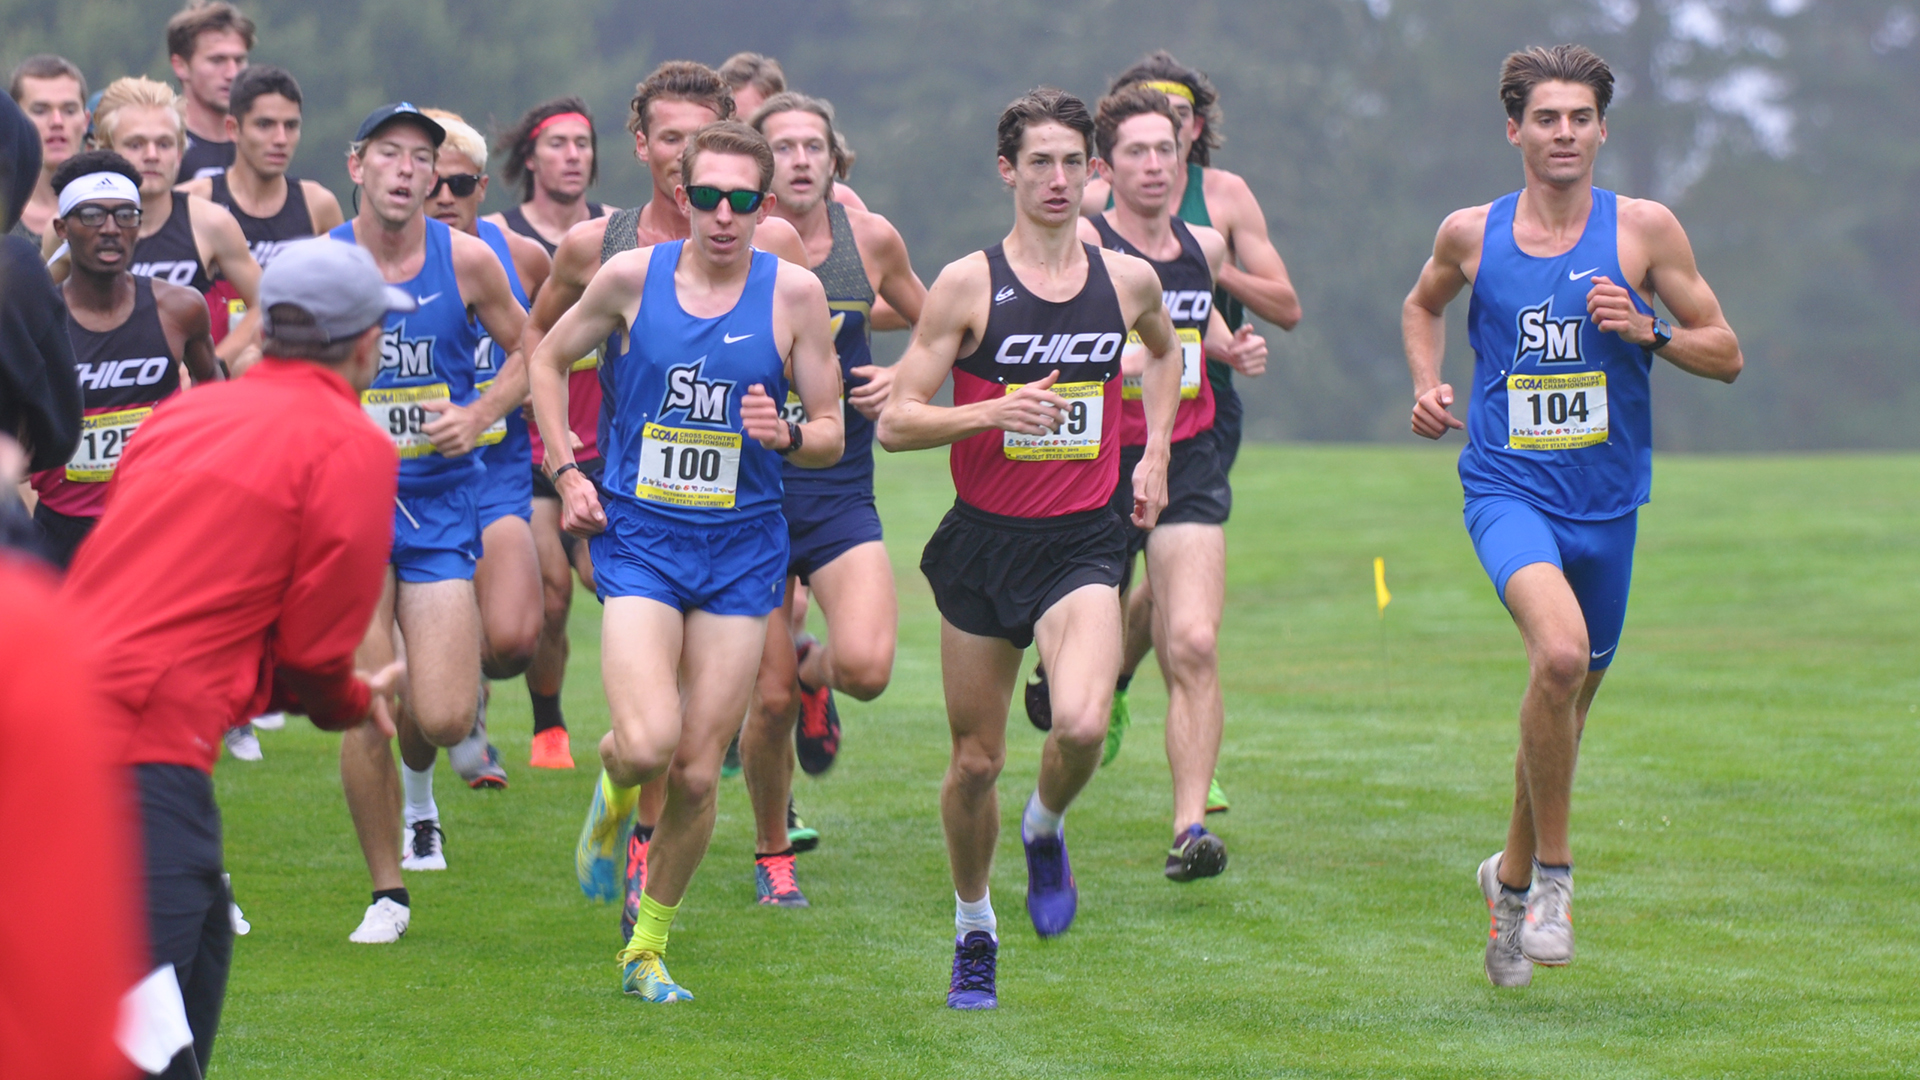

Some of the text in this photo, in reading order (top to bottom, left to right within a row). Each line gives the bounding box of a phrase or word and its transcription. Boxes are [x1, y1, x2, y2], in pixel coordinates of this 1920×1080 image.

[1162, 289, 1212, 321] ICO
[994, 332, 1122, 364] CHICO
[1516, 302, 1582, 363] SM
[376, 327, 433, 380] SM
[75, 356, 168, 390] HICO
[1514, 378, 1542, 390] CCAA
[1544, 381, 1599, 390] CHAMPIONSHIPS
[661, 363, 731, 424] SM
[1526, 391, 1589, 426] 104
[389, 404, 425, 435] 99
[651, 428, 678, 443] CCAA
[679, 438, 735, 447] CHAMPIONSHIPS
[704, 433, 736, 442] COUNTRY
[661, 446, 721, 482] 100
[648, 493, 675, 503] HUMBOLDT
